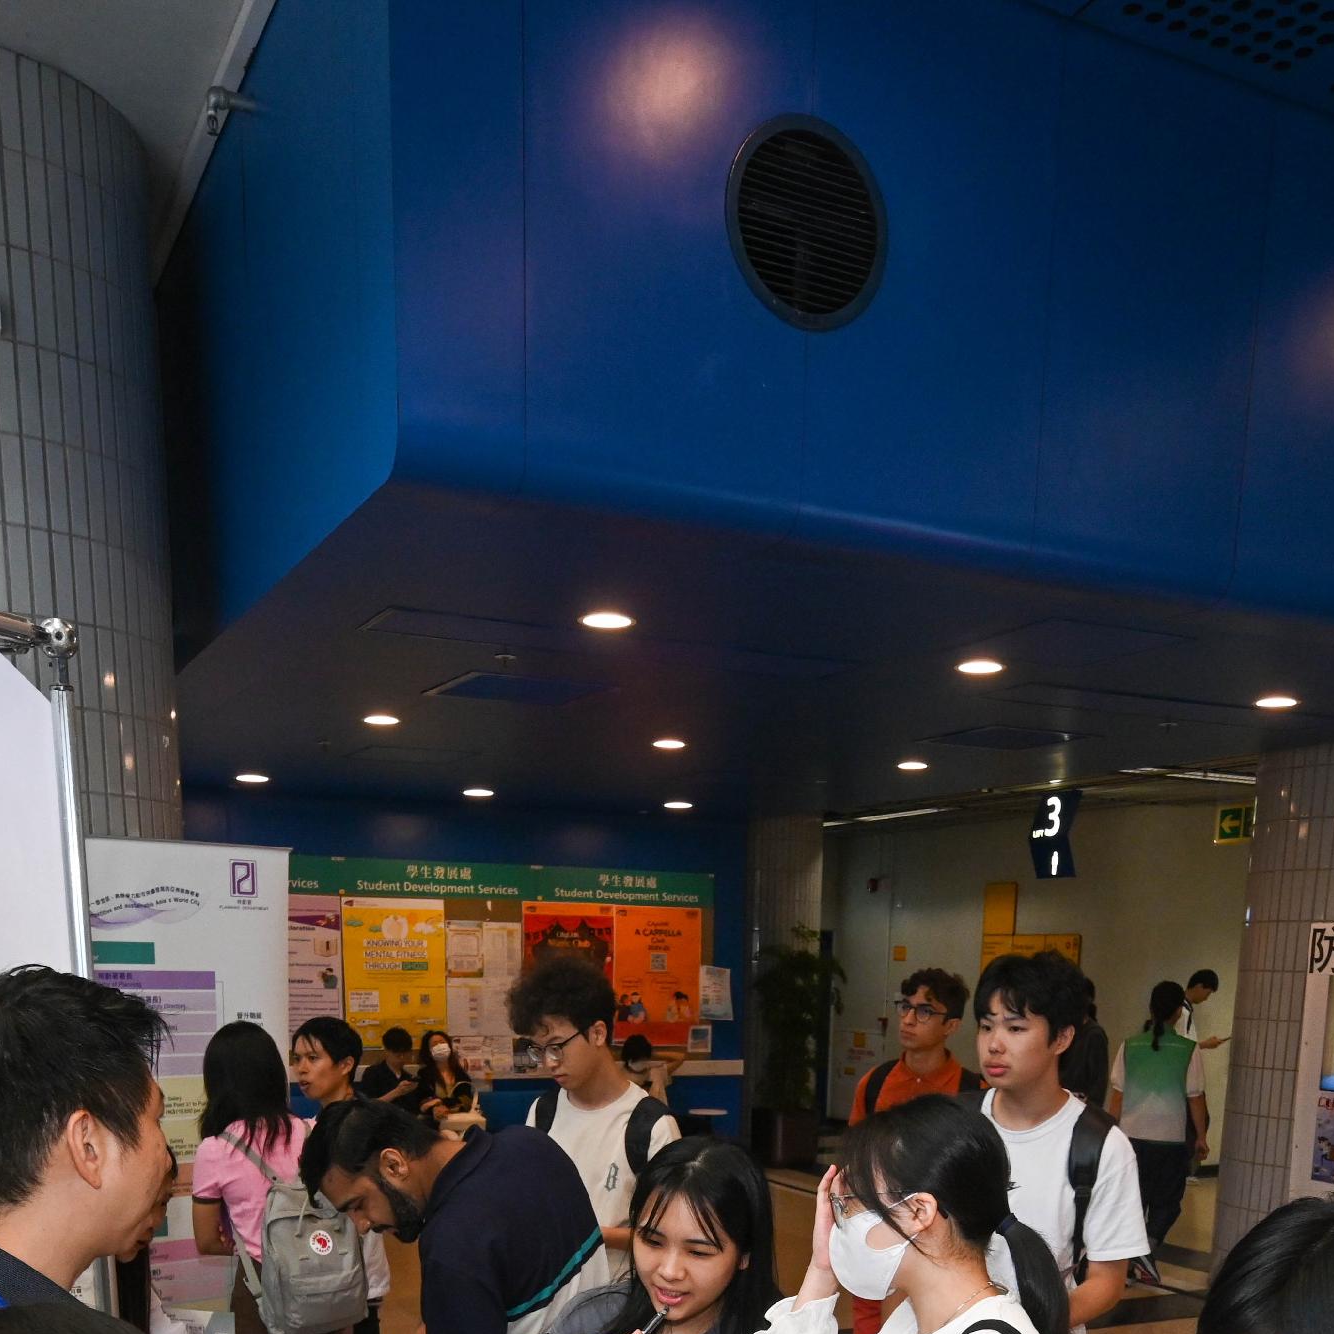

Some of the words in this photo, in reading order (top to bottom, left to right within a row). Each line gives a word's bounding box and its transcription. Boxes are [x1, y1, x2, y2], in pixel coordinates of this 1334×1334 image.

[1044, 796, 1061, 837] 3
[406, 864, 473, 881] 學生發展處
[287, 877, 319, 889] rvices
[357, 879, 400, 892] Student
[403, 881, 475, 896] Development
[477, 883, 519, 896] Services
[554, 887, 593, 898] Student
[595, 889, 660, 902] Development
[661, 892, 699, 903] Services
[364, 950, 395, 959] MENTAL
